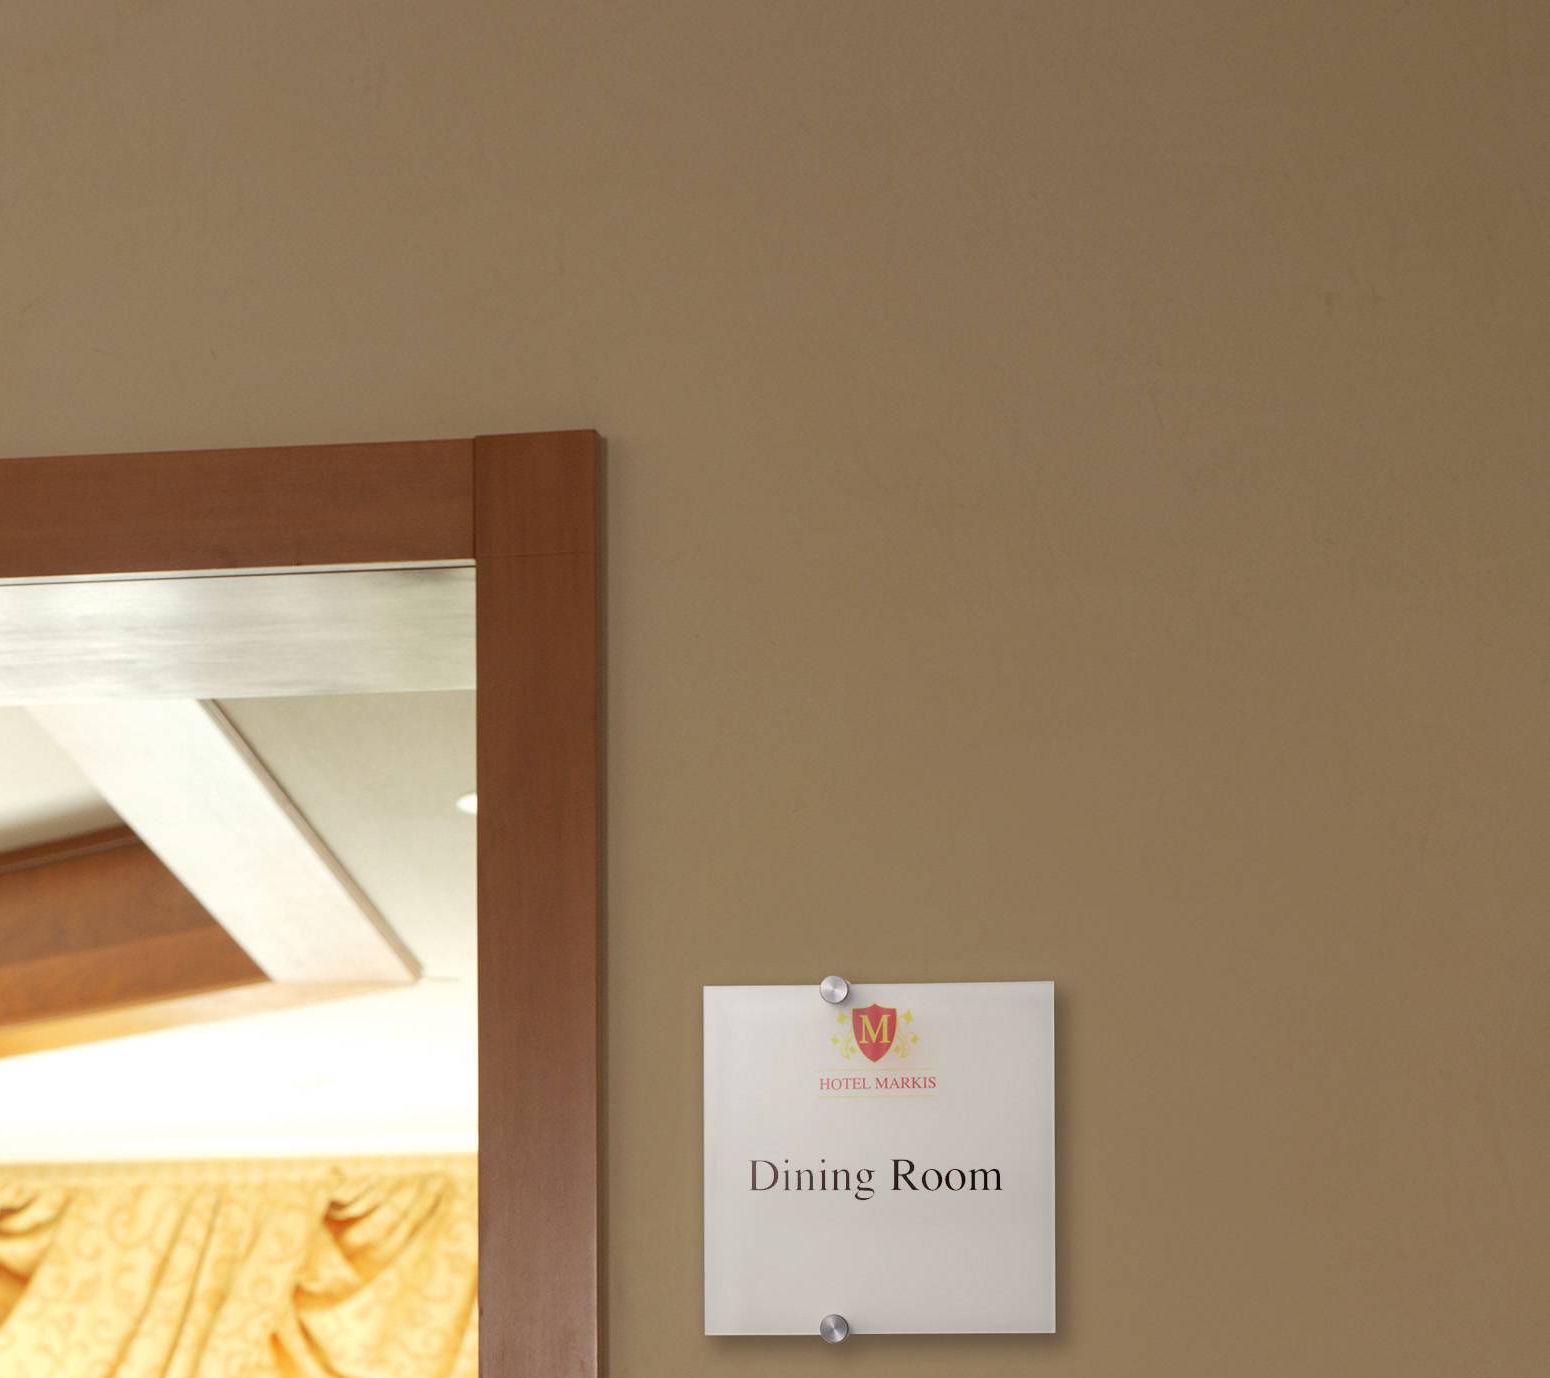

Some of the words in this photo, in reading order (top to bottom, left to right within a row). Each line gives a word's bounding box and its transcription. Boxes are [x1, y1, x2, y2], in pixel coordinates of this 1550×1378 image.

[859, 1015, 891, 1044] M
[819, 1077, 871, 1090] HOTEL
[875, 1076, 937, 1089] MARKIS
[749, 1159, 875, 1200] Dining
[890, 1159, 1003, 1191] Room
